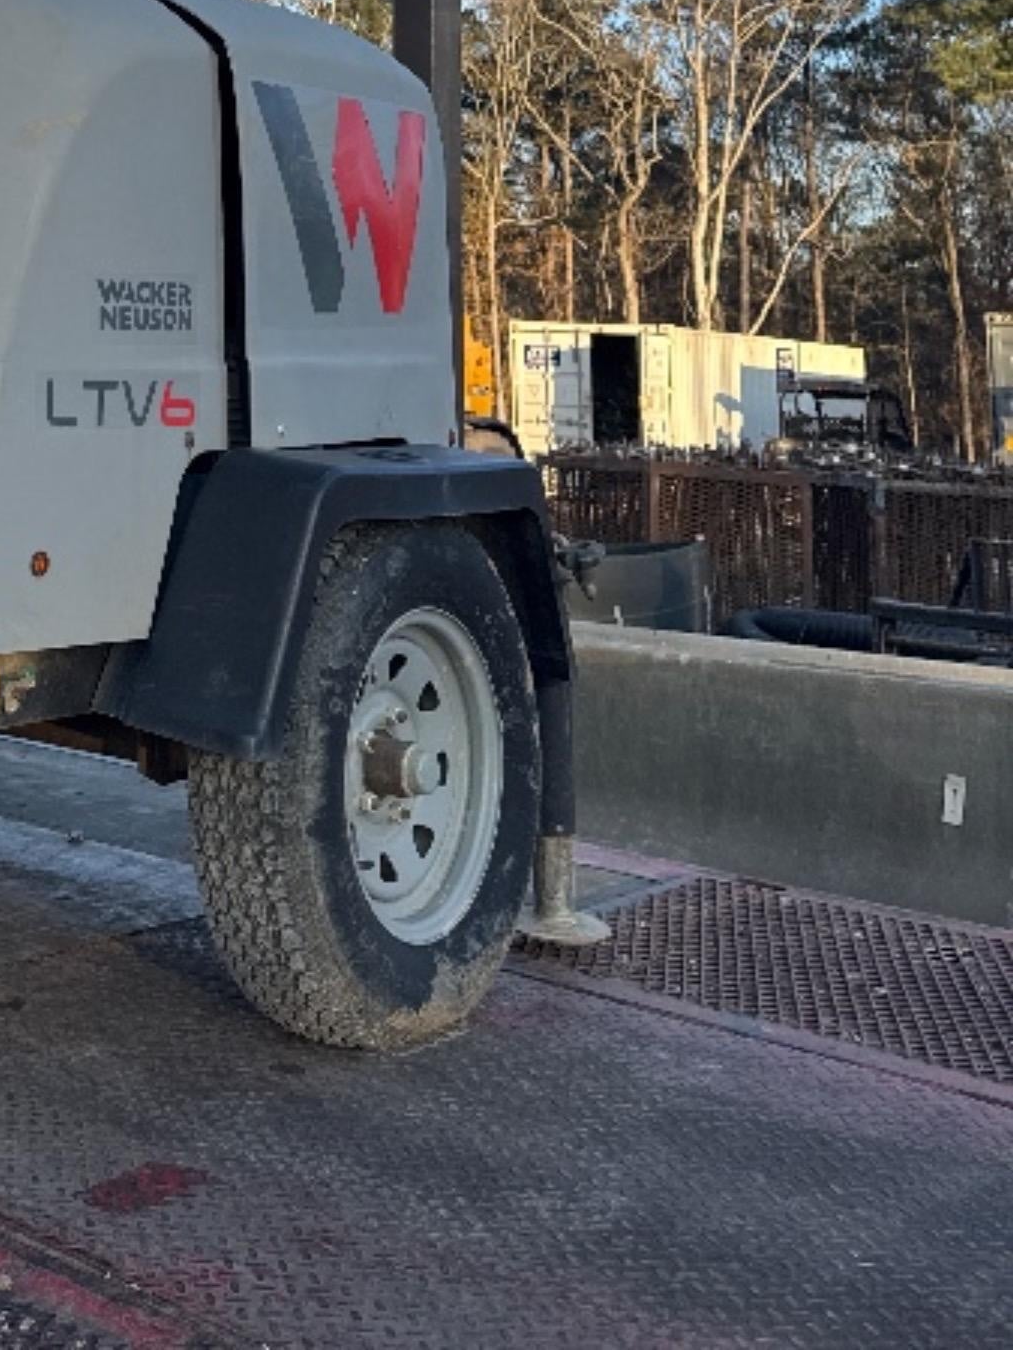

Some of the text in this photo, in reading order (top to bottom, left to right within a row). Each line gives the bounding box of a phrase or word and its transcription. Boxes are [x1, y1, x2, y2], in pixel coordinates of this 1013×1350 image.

[96, 278, 193, 307] WACKER
[98, 305, 193, 331] NEUSON
[46, 378, 196, 427] LTV6
